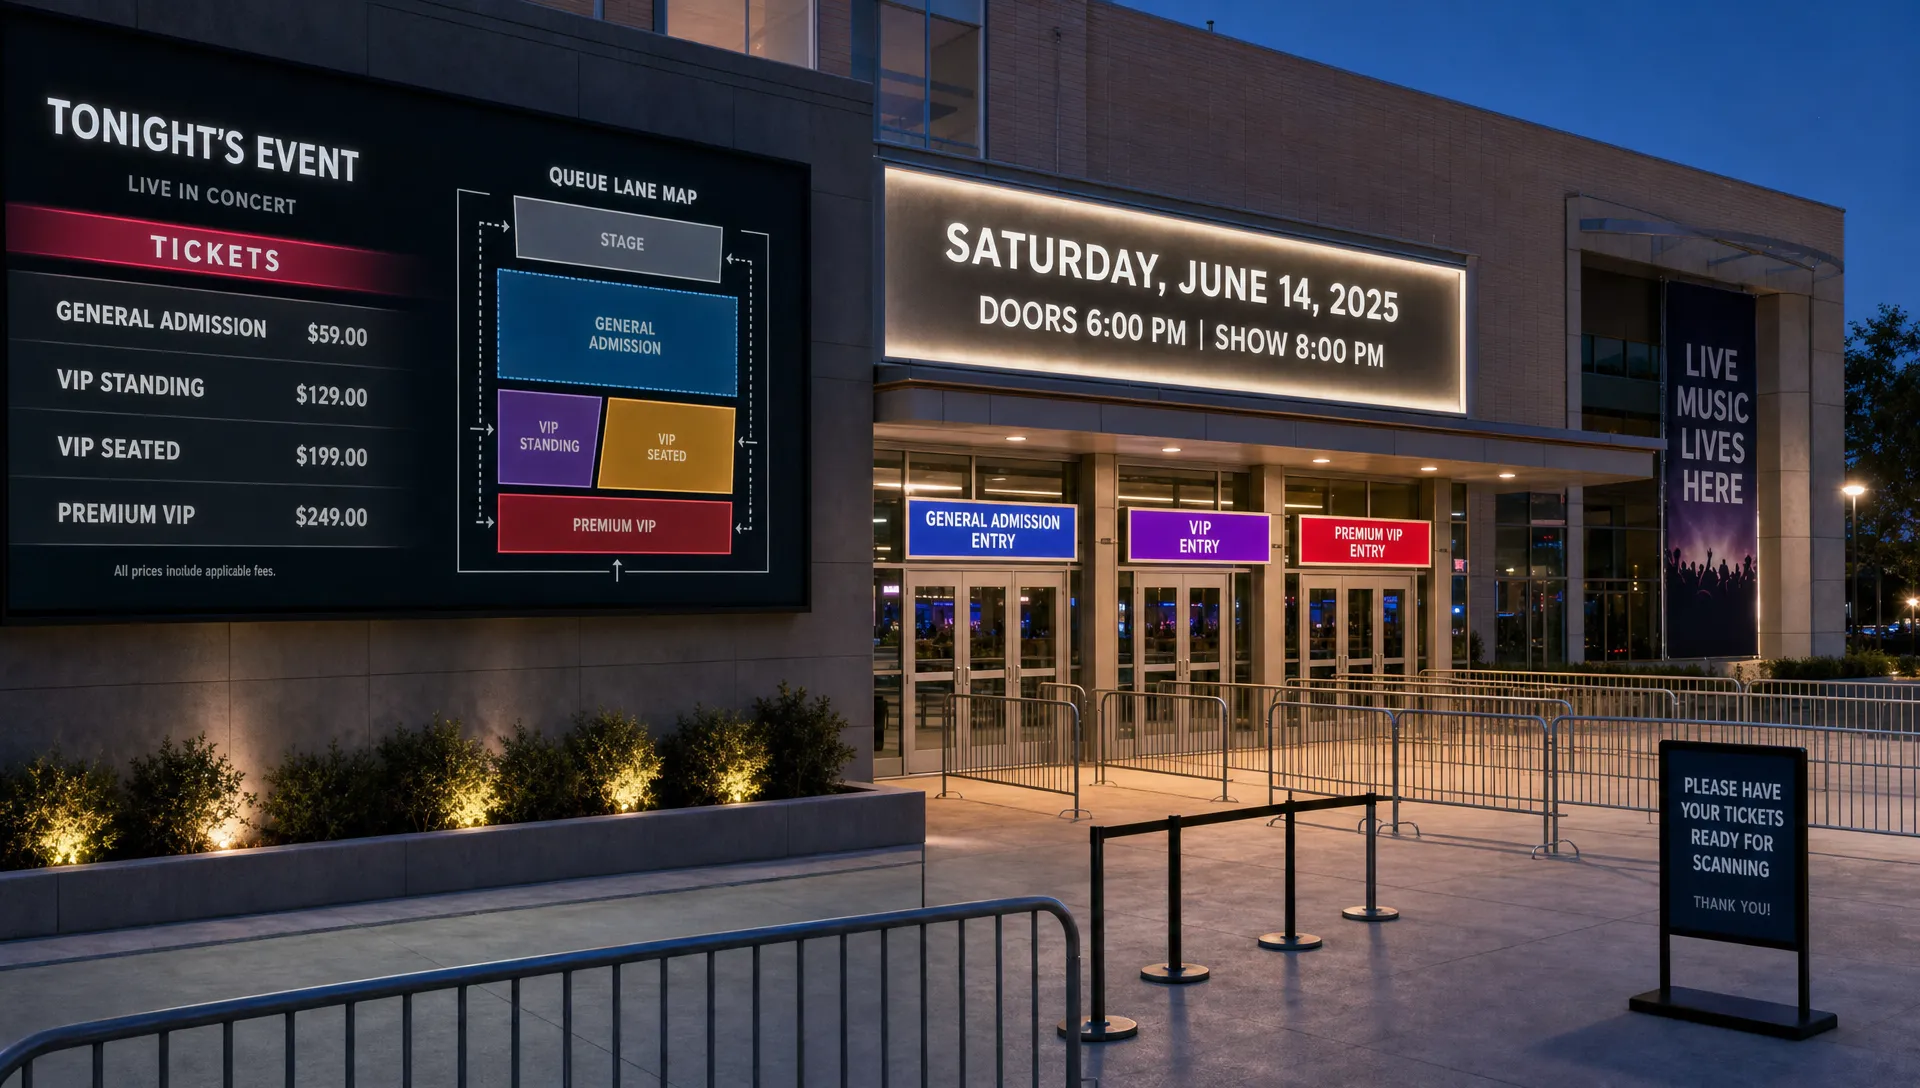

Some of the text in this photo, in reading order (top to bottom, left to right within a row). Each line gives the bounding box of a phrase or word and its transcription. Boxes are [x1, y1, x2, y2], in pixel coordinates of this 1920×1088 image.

[48, 98, 359, 181] TONIGHT'S EVENT
[129, 175, 296, 214] LIVE IN CONCERT
[550, 167, 697, 204] QUEUE LANE MAP
[151, 235, 279, 271] TICKETS
[601, 233, 644, 251] STAGE
[946, 222, 1398, 322] SATURDAY, JUNE 14, 2025
[57, 301, 266, 338] GENERAL ADMISSION
[595, 317, 655, 336] GENERAL
[308, 322, 367, 346] $59.00
[980, 295, 1077, 333] DOORS
[1087, 309, 1143, 341] 6:00
[1152, 317, 1185, 345] PM
[1215, 324, 1288, 356] SHOW
[1296, 334, 1346, 363] 8:00
[1355, 341, 1383, 367] PM
[589, 336, 661, 355] ADMISSION
[1687, 343, 1737, 381] LIVE
[57, 369, 204, 397] VIP STANDING
[297, 383, 367, 407] $129.00
[1678, 386, 1749, 423] MUSIC
[539, 421, 558, 433] VIP
[58, 436, 180, 460] VIP SEATED
[521, 438, 579, 452] STANDING
[659, 433, 675, 445] VIP
[1682, 428, 1745, 463] LIVES
[297, 445, 367, 466] $199.00
[648, 449, 686, 461] SEATED
[1684, 470, 1743, 504] HERE
[59, 503, 195, 524] PREMIUM VIP
[296, 505, 367, 527] $249.00
[926, 511, 1059, 529] GENERAL ADMISSION
[574, 518, 656, 532] PREMIUM VIP
[1189, 520, 1211, 535] VIP
[1335, 526, 1403, 541] PREMIUM VIP
[972, 533, 1015, 548] ENTRY
[1180, 539, 1219, 553] ENTRY
[1351, 544, 1385, 557] ENTRY
[114, 565, 127, 576] All
[132, 565, 162, 579] prices
[206, 565, 251, 579] applicable
[254, 565, 275, 576] fees.
[1685, 777, 1781, 800] PLEASE HAVE
[1681, 802, 1783, 826] YOUR TICKETS
[1692, 829, 1773, 851] READY FOR
[1693, 854, 1769, 877] SCANNING
[1694, 896, 1770, 915] THANK YOU!
